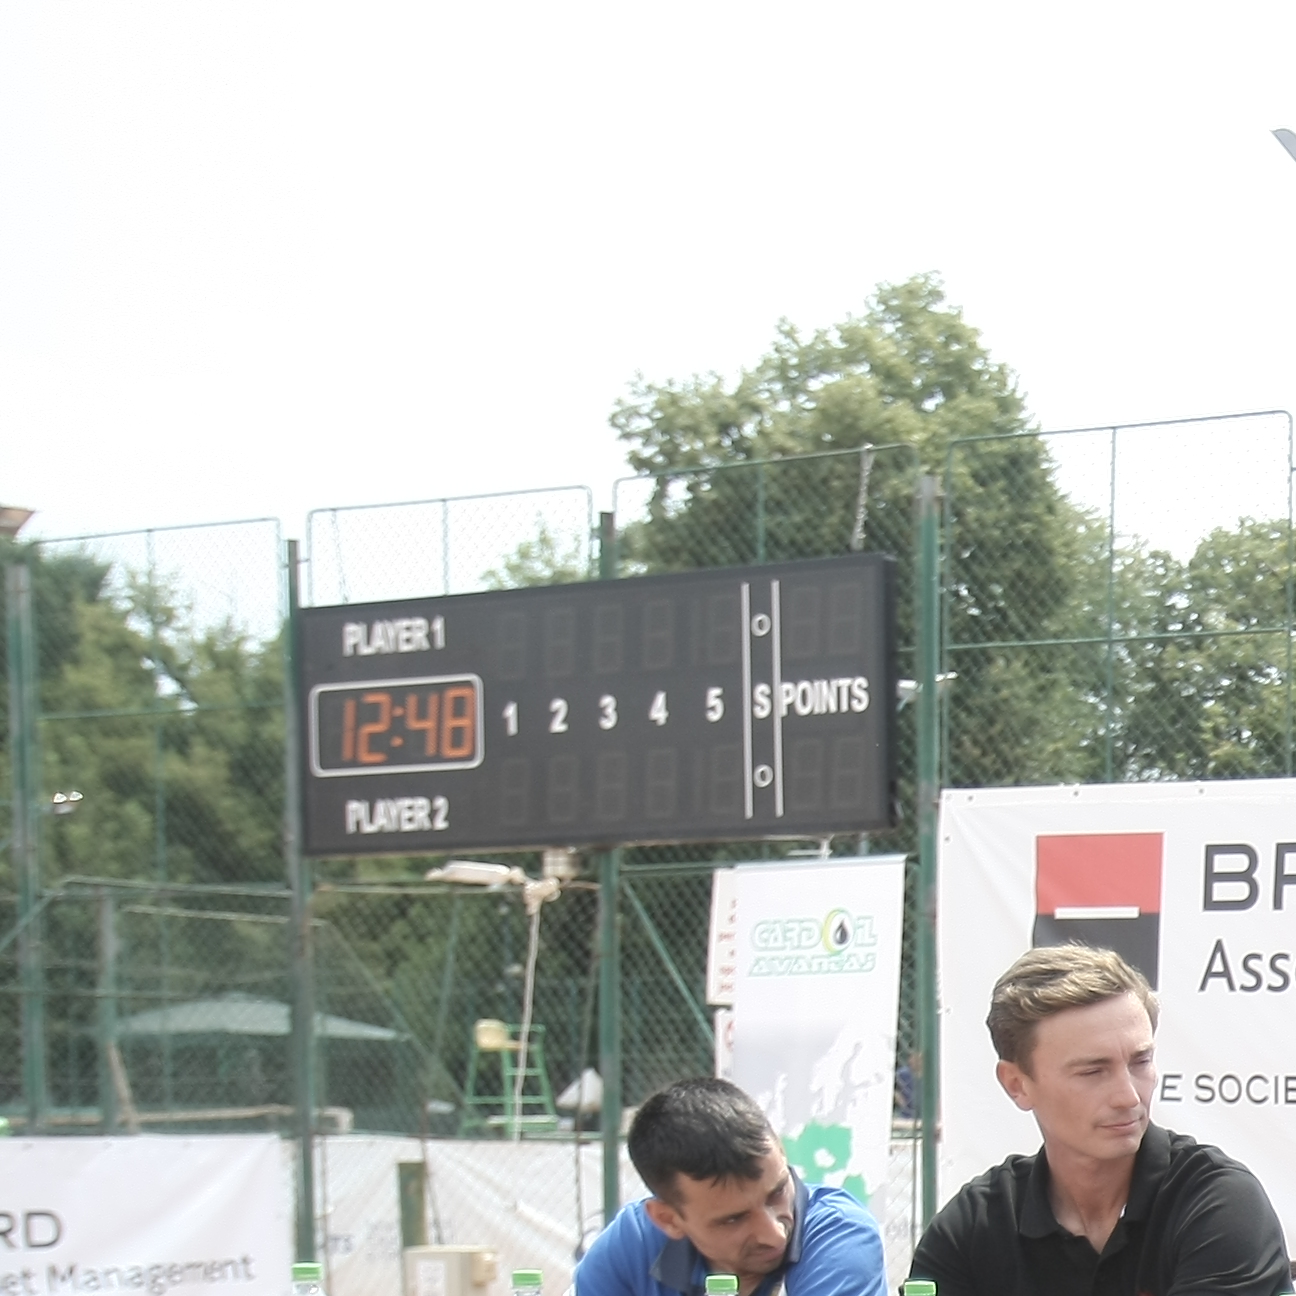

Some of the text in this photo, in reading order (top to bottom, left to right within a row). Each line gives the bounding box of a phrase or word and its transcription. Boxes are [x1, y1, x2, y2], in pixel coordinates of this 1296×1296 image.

[343, 617, 445, 656] PLAYER 1
[502, 687, 725, 737] 1 2 3 4 5
[780, 677, 869, 718] POINTS
[340, 686, 477, 764] 12:48
[345, 797, 448, 834] PLAYER 2
[0, 1211, 63, 1248] RD
[47, 1255, 255, 1296] Management
